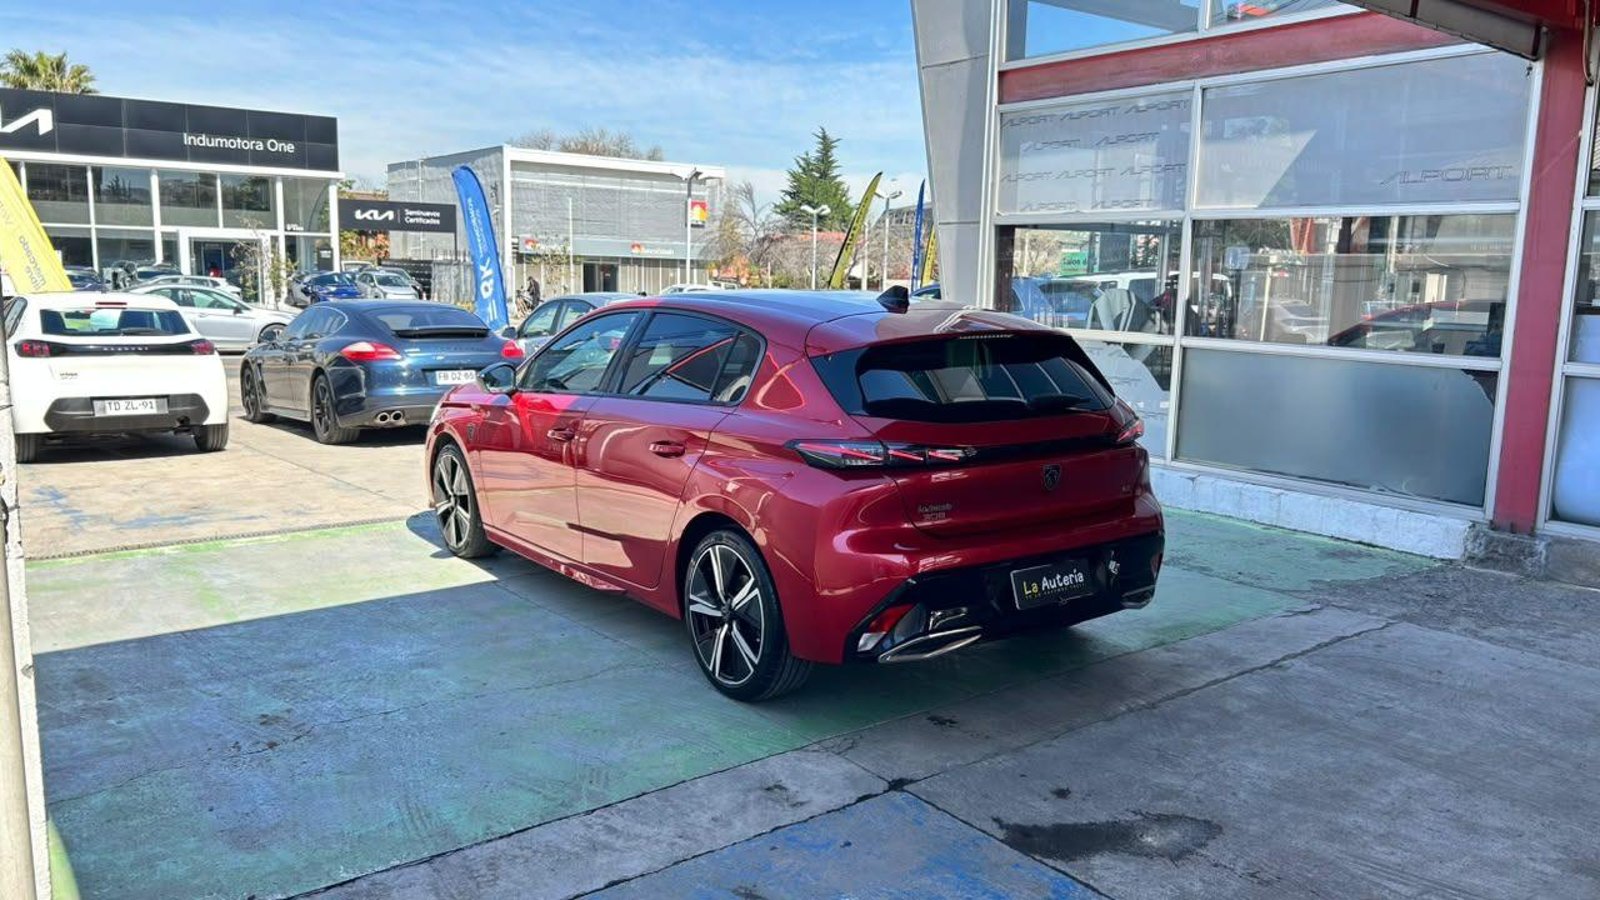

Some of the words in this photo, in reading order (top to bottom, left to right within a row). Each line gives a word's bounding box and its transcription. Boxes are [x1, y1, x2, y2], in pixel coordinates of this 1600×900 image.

[183, 132, 264, 150] Indumotora
[266, 139, 295, 153] One
[1023, 581, 1039, 596] La
